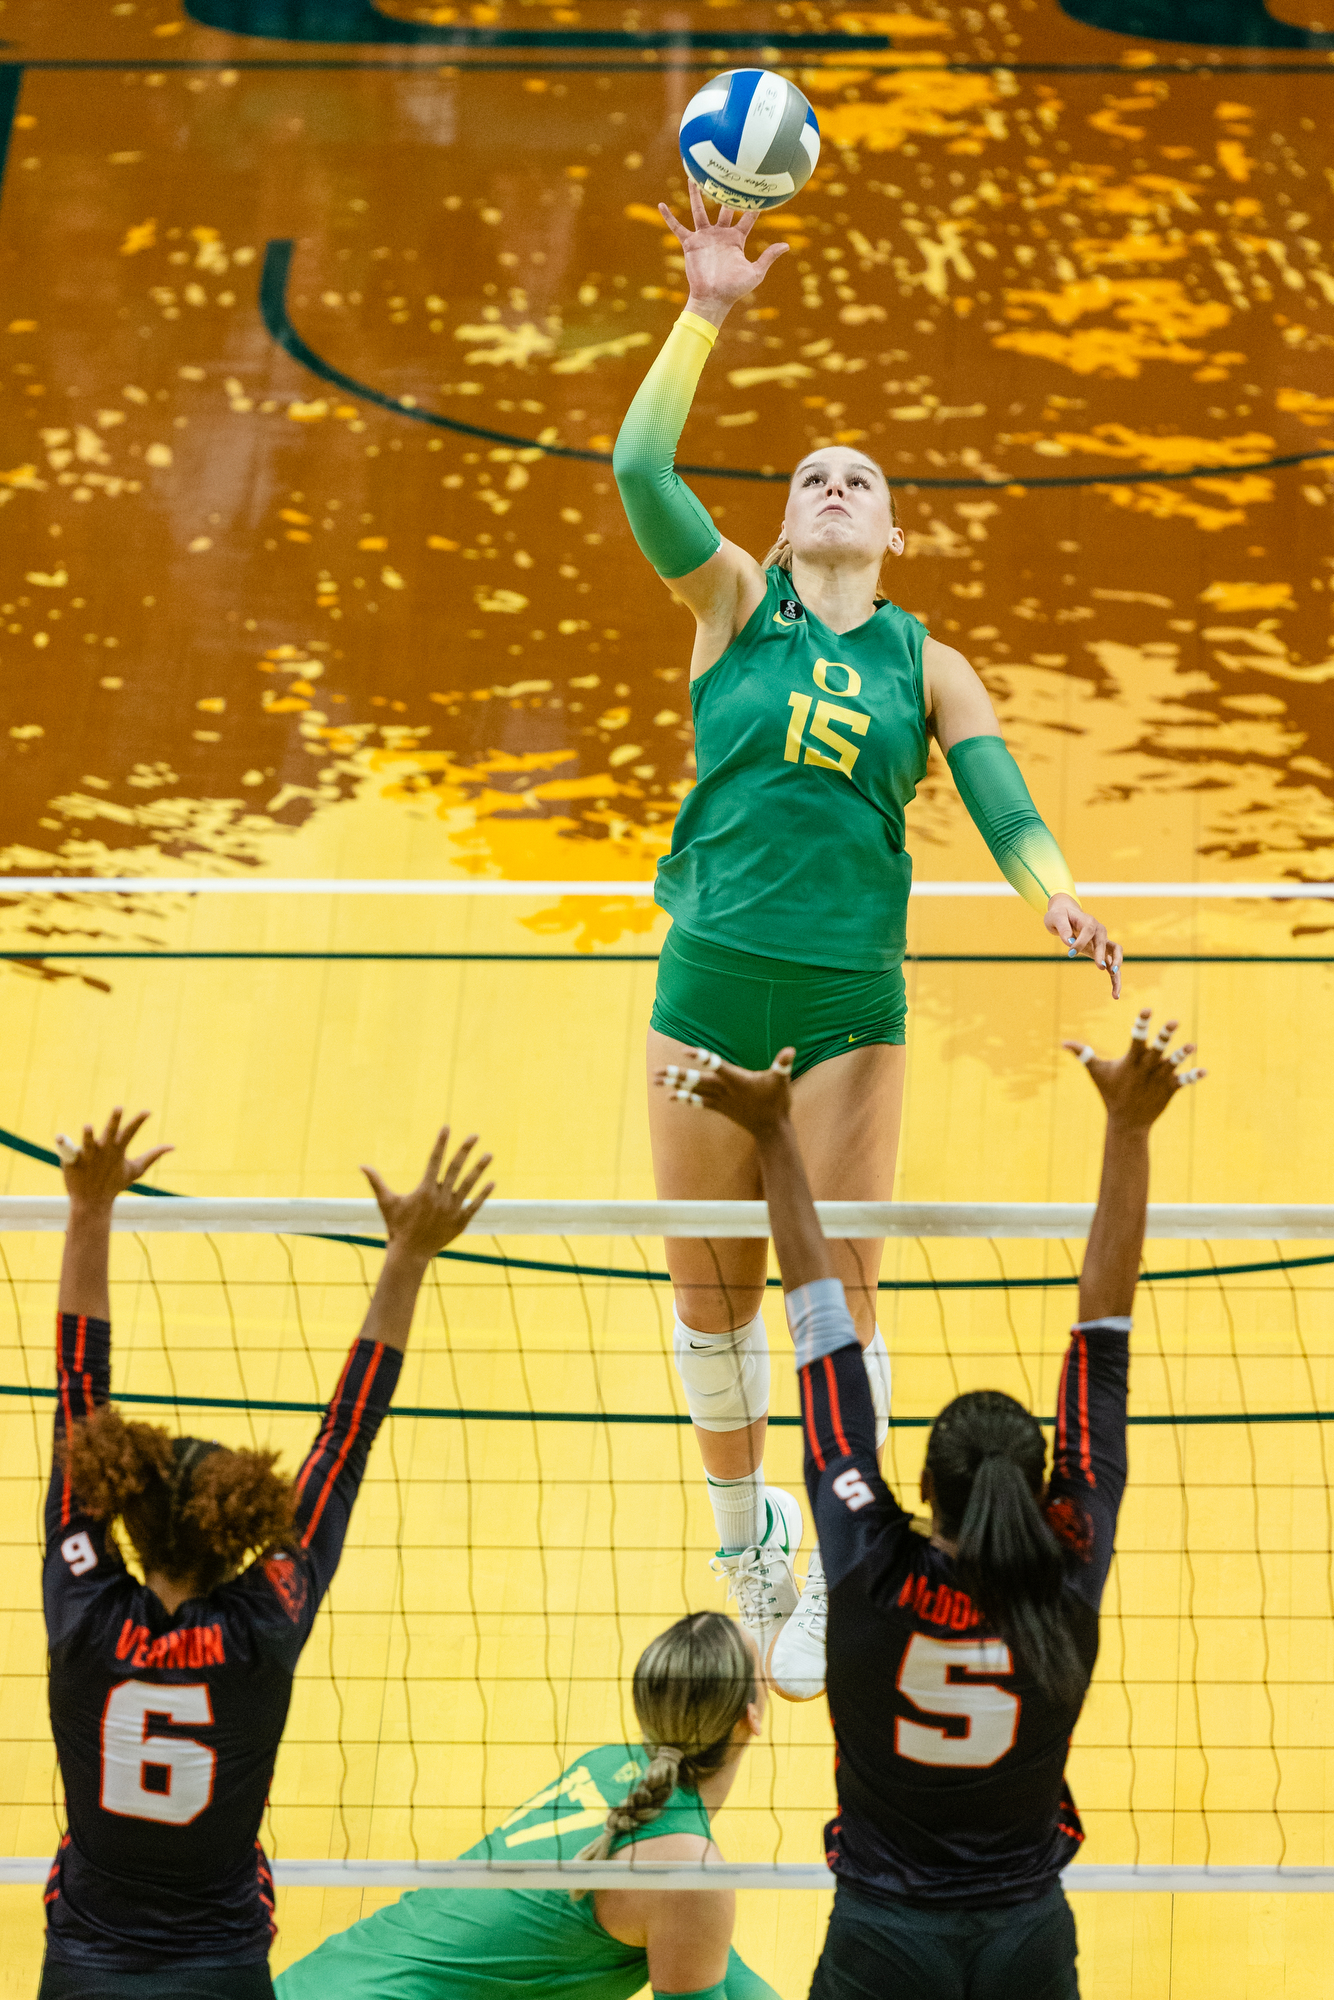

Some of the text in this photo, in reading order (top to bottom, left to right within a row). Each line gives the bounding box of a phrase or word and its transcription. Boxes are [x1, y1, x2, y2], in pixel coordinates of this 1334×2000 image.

[706, 159, 741, 183] Touch
[743, 178, 778, 193] Super
[784, 691, 871, 780] 15
[115, 1618, 226, 1669] VERNON
[894, 1631, 1022, 1769] 5
[99, 1679, 217, 1827] 6
